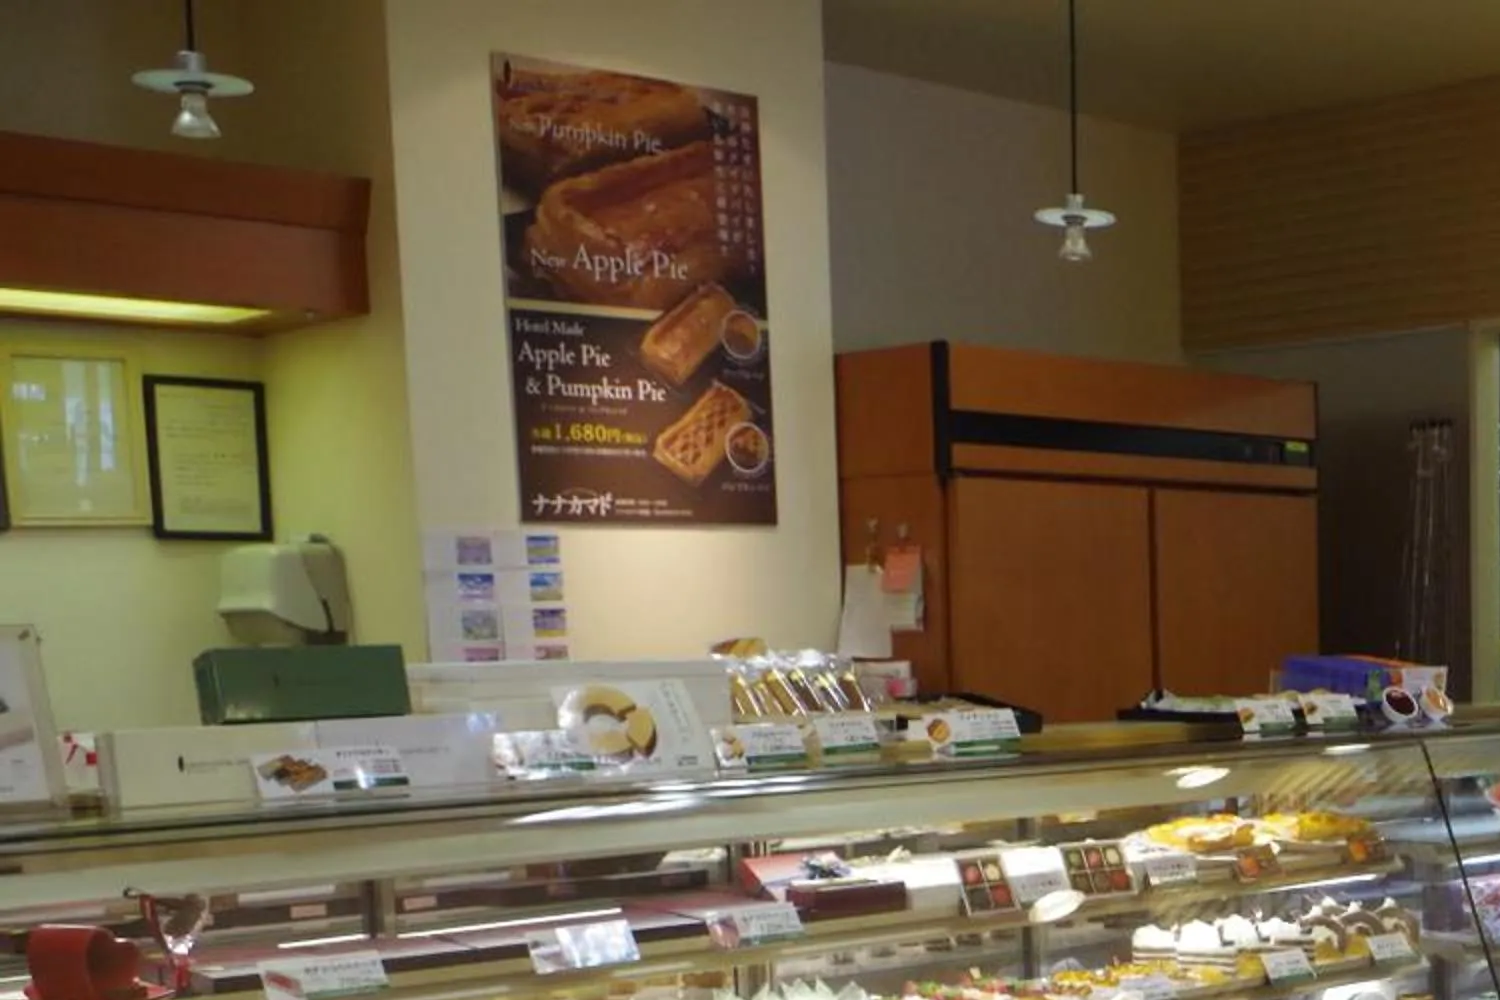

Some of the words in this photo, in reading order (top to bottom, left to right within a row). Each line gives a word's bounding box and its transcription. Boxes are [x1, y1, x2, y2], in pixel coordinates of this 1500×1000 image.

[539, 114, 628, 151] Pumpkin
[633, 130, 663, 152] Pie
[531, 247, 567, 269] New
[572, 243, 645, 283] Apple
[652, 250, 689, 280] Pie
[517, 341, 577, 371] Apple
[581, 344, 611, 368] Pie
[525, 377, 542, 396] &
[547, 373, 633, 406] Pumpkin
[637, 379, 667, 402] Pie
[532, 491, 613, 517] ナナカマド
